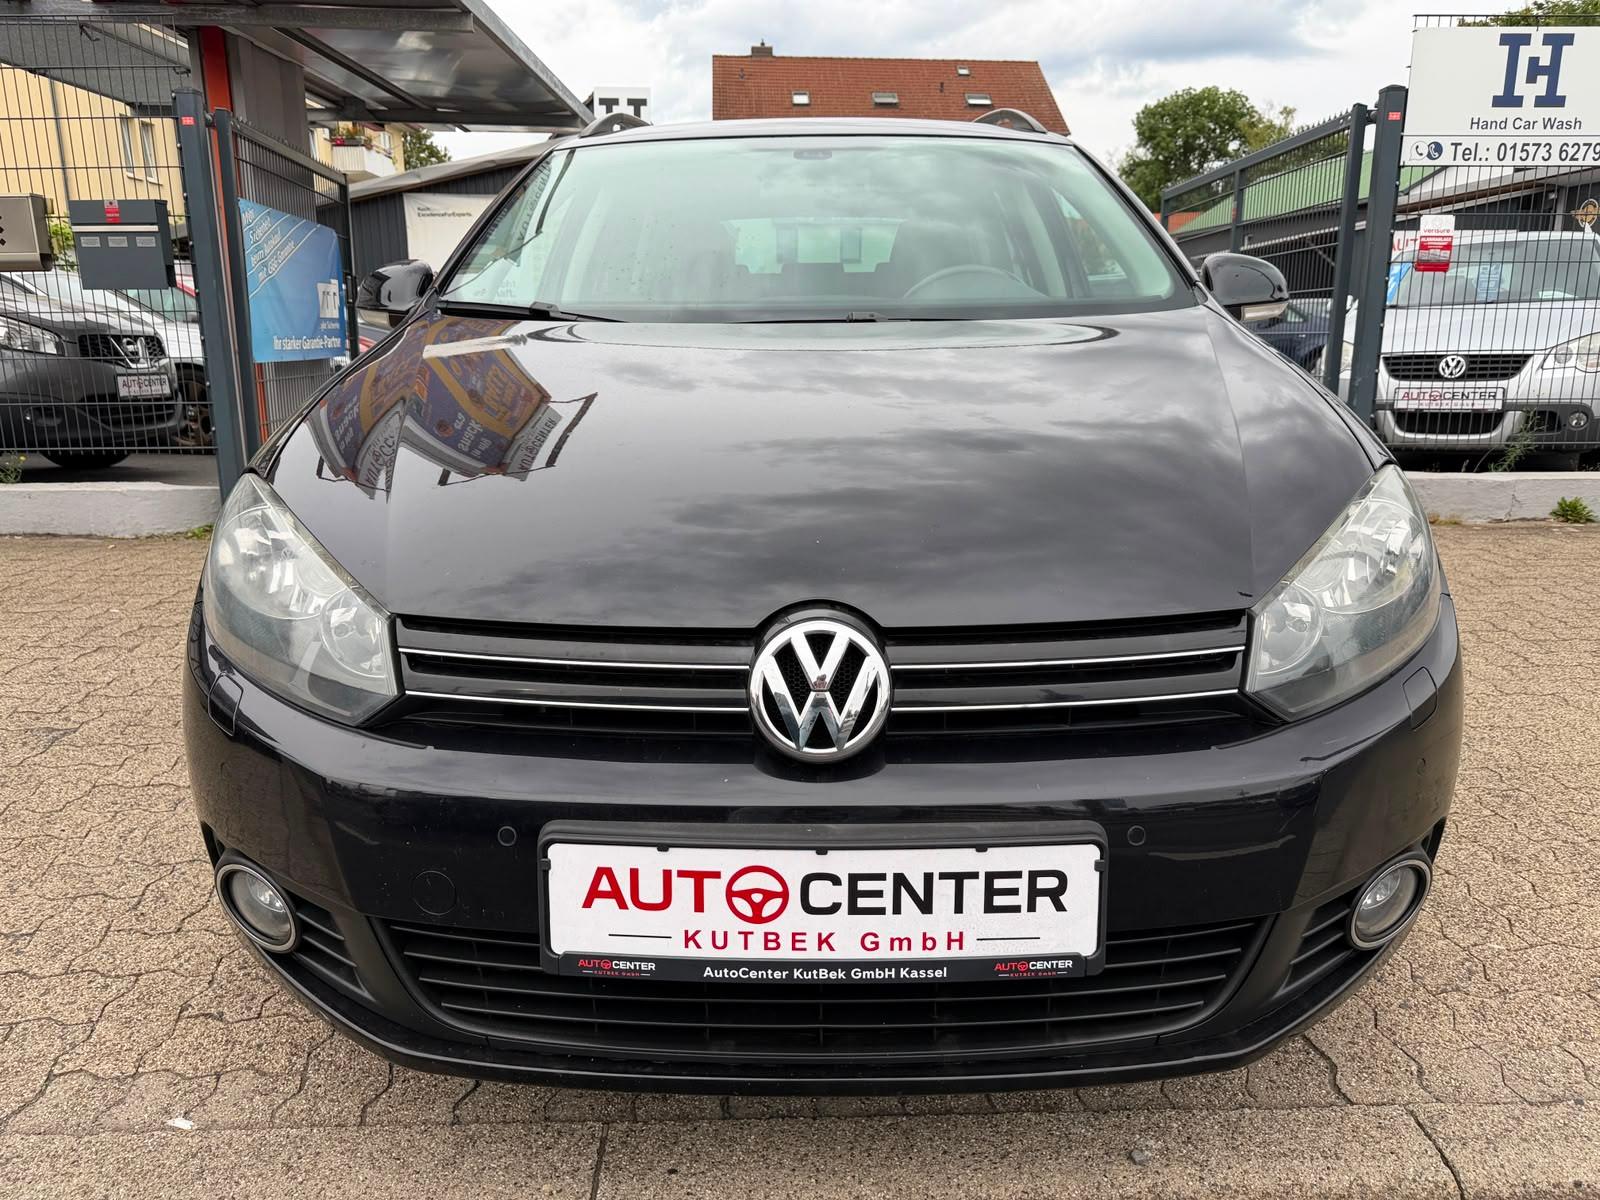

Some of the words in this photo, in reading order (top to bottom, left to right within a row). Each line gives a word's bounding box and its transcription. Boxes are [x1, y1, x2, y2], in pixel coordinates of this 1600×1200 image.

[1469, 117, 1507, 130] Hand
[1512, 117, 1538, 130] Car
[1542, 117, 1582, 130] Wash
[1450, 142, 1490, 162] Tel.:
[1497, 142, 1552, 162] 01573
[683, 929, 836, 952] KUTBEK
[860, 931, 964, 951] GmbH
[703, 967, 789, 981] AutoCenter
[793, 968, 846, 980] KutBek
[851, 967, 896, 979] GmbH
[900, 967, 948, 979] Kassel
